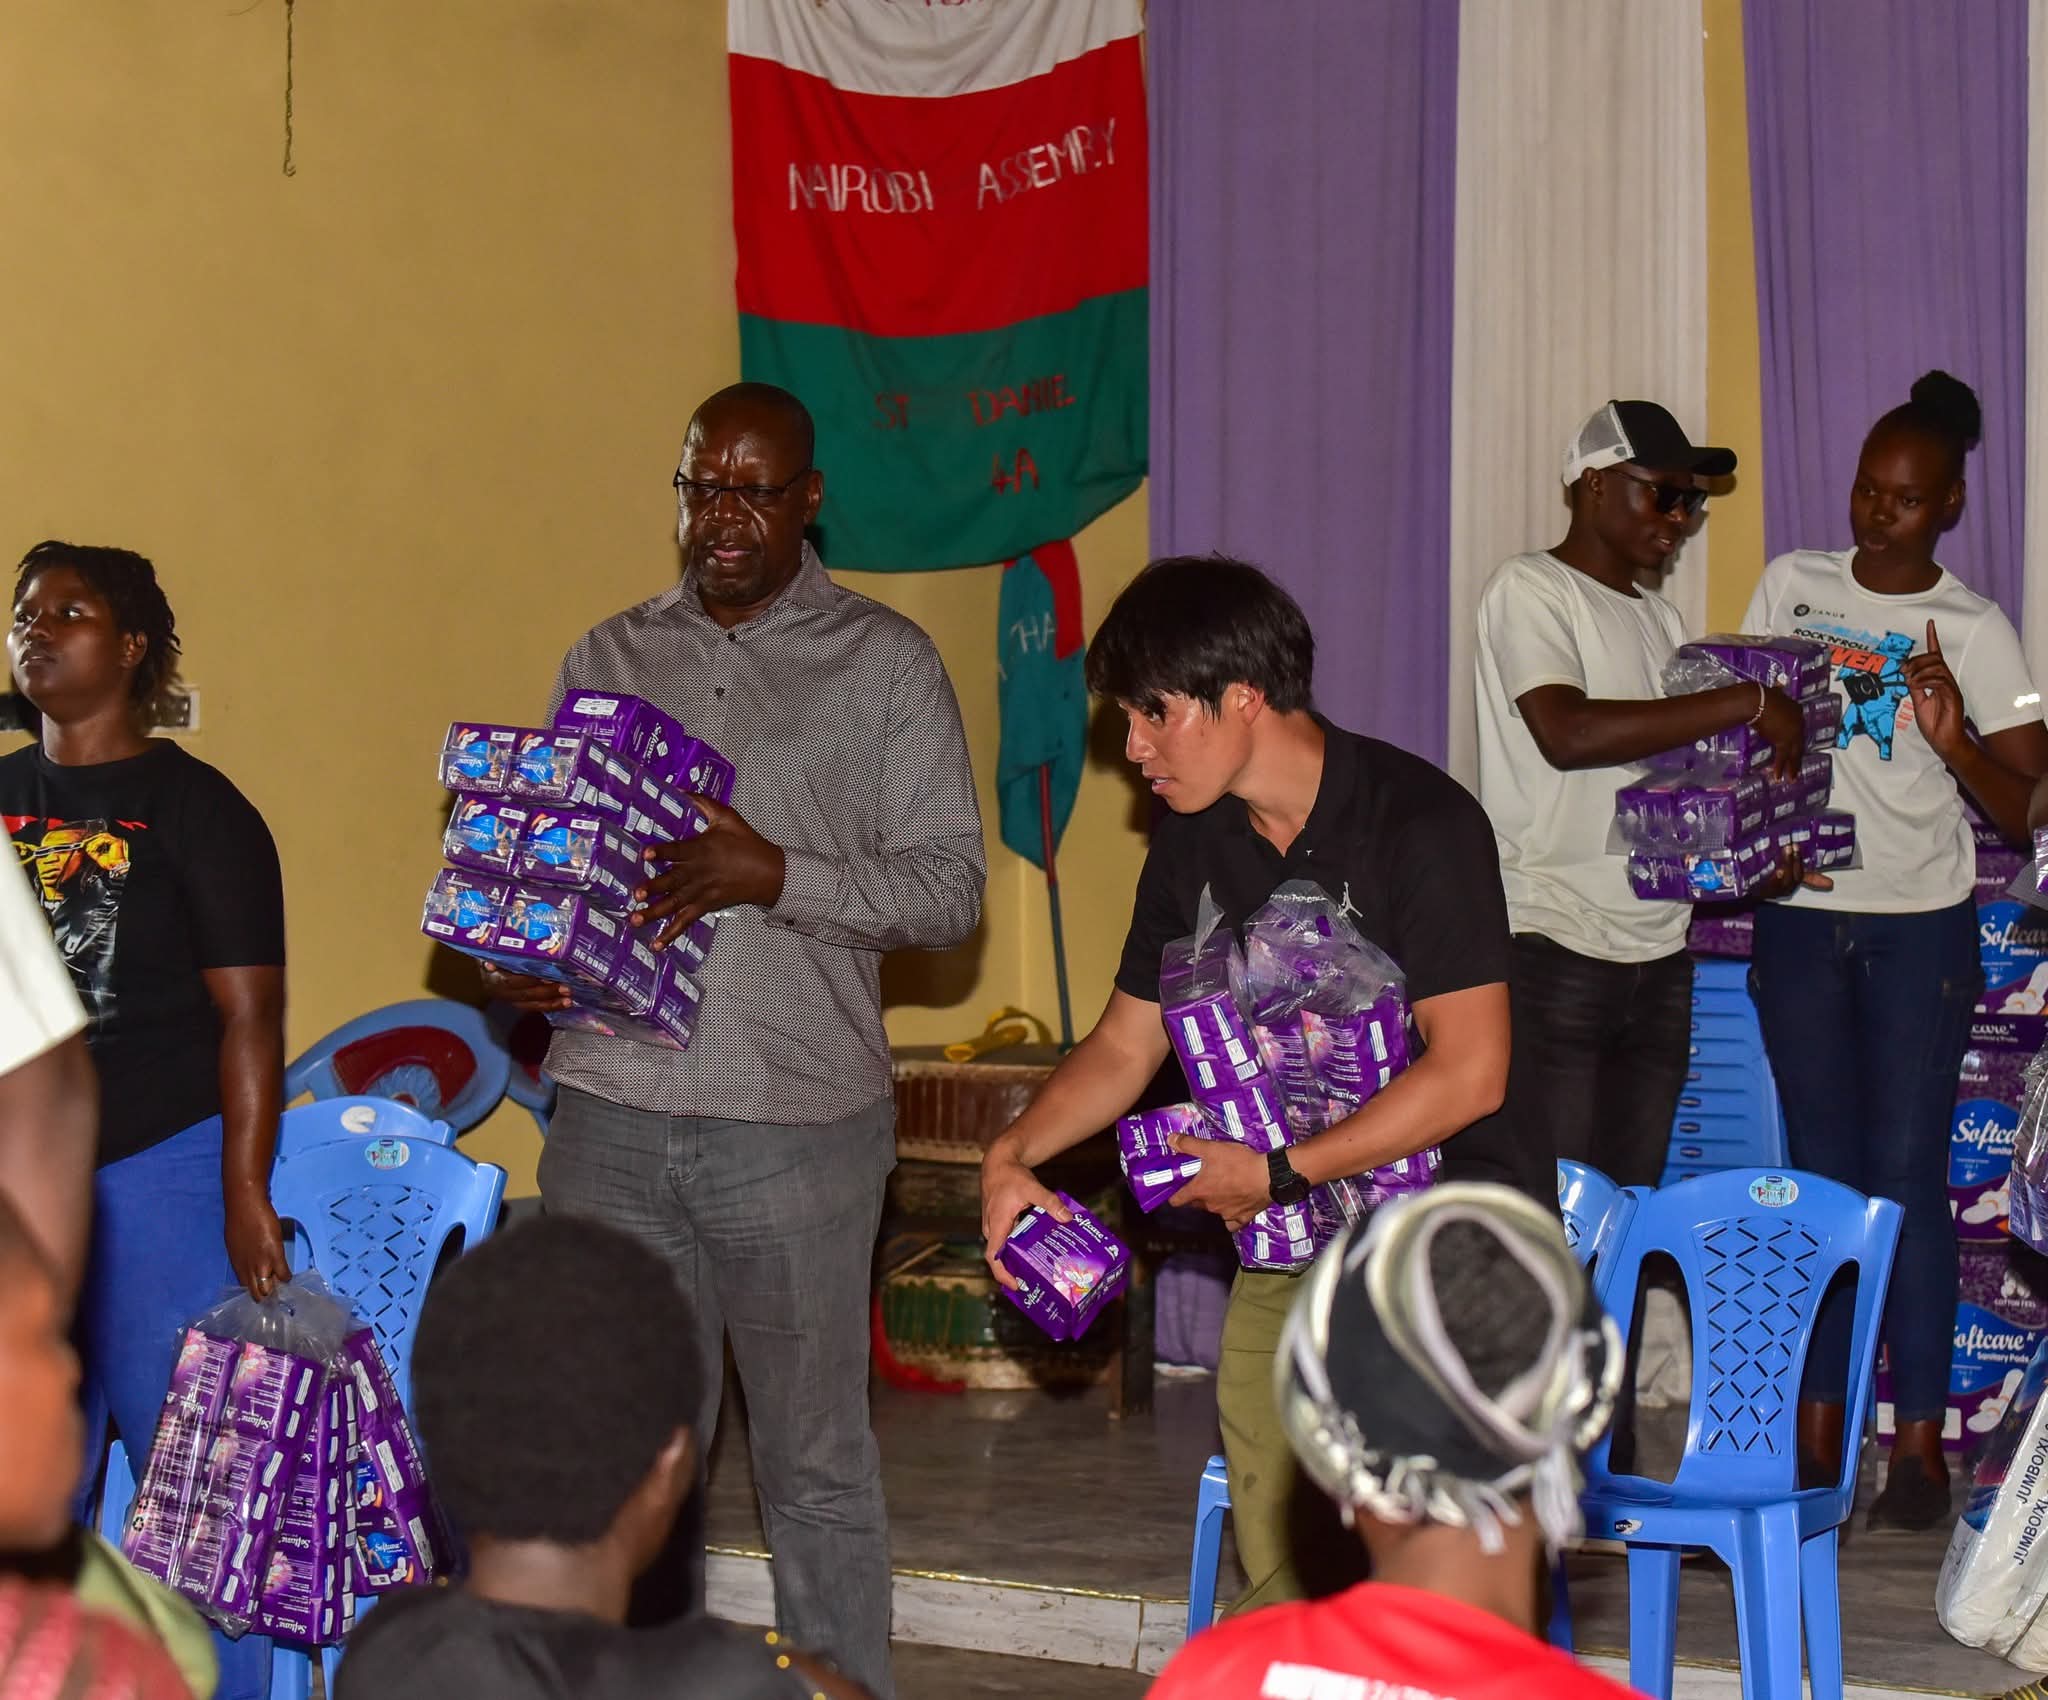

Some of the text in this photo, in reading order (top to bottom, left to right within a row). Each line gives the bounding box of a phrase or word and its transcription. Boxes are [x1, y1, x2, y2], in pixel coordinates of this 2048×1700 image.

[788, 162, 935, 214] NAIROBI
[1828, 644, 1888, 674] VER
[1952, 1119, 2016, 1151] Softca
[1954, 1324, 2024, 1357] oftcare
